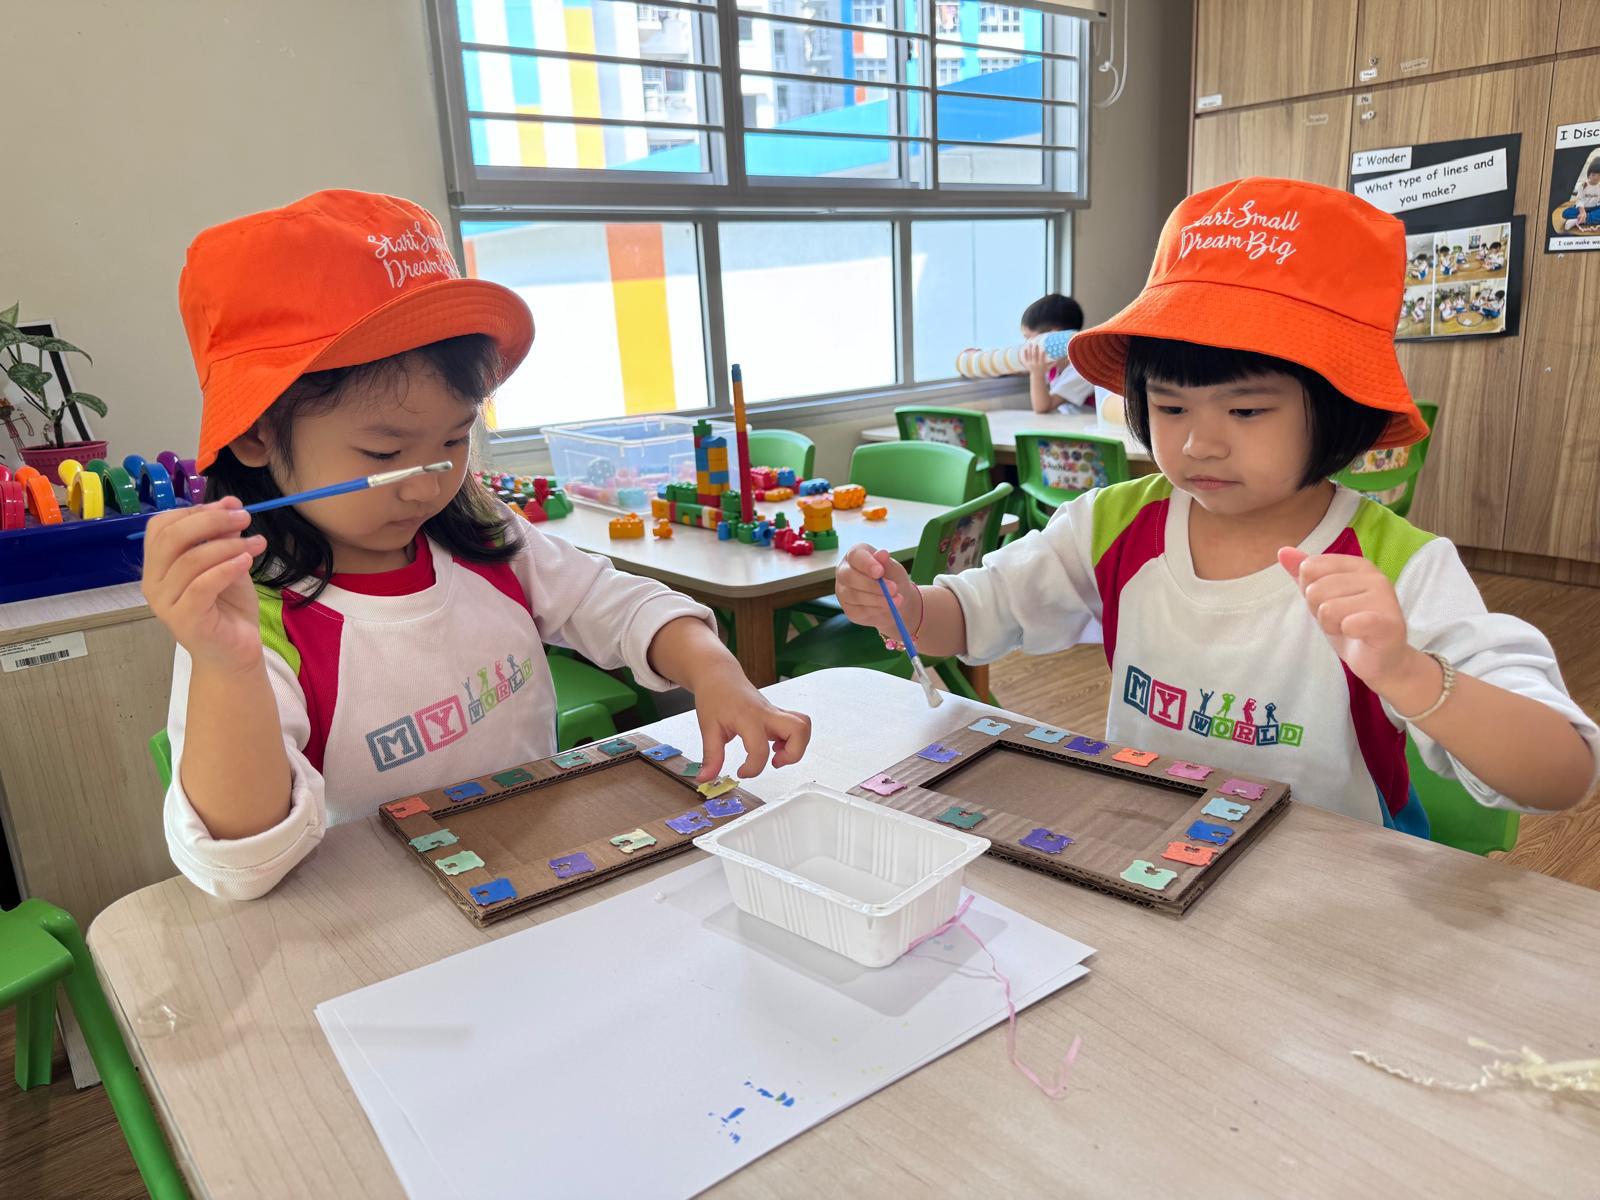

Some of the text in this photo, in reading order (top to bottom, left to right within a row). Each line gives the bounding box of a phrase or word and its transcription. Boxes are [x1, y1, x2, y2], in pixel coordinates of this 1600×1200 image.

[1560, 127, 1600, 140] I Disc
[1356, 153, 1407, 167] I Wonder
[1365, 155, 1494, 194] What type of lines and
[1399, 183, 1457, 207] you make?
[1232, 200, 1300, 231] Small
[367, 228, 419, 259] Start
[1180, 230, 1297, 265] Dream Big
[383, 259, 442, 289] Dream
[376, 662, 531, 764] MY WORLD
[1128, 673, 1299, 743] MY WORLD
